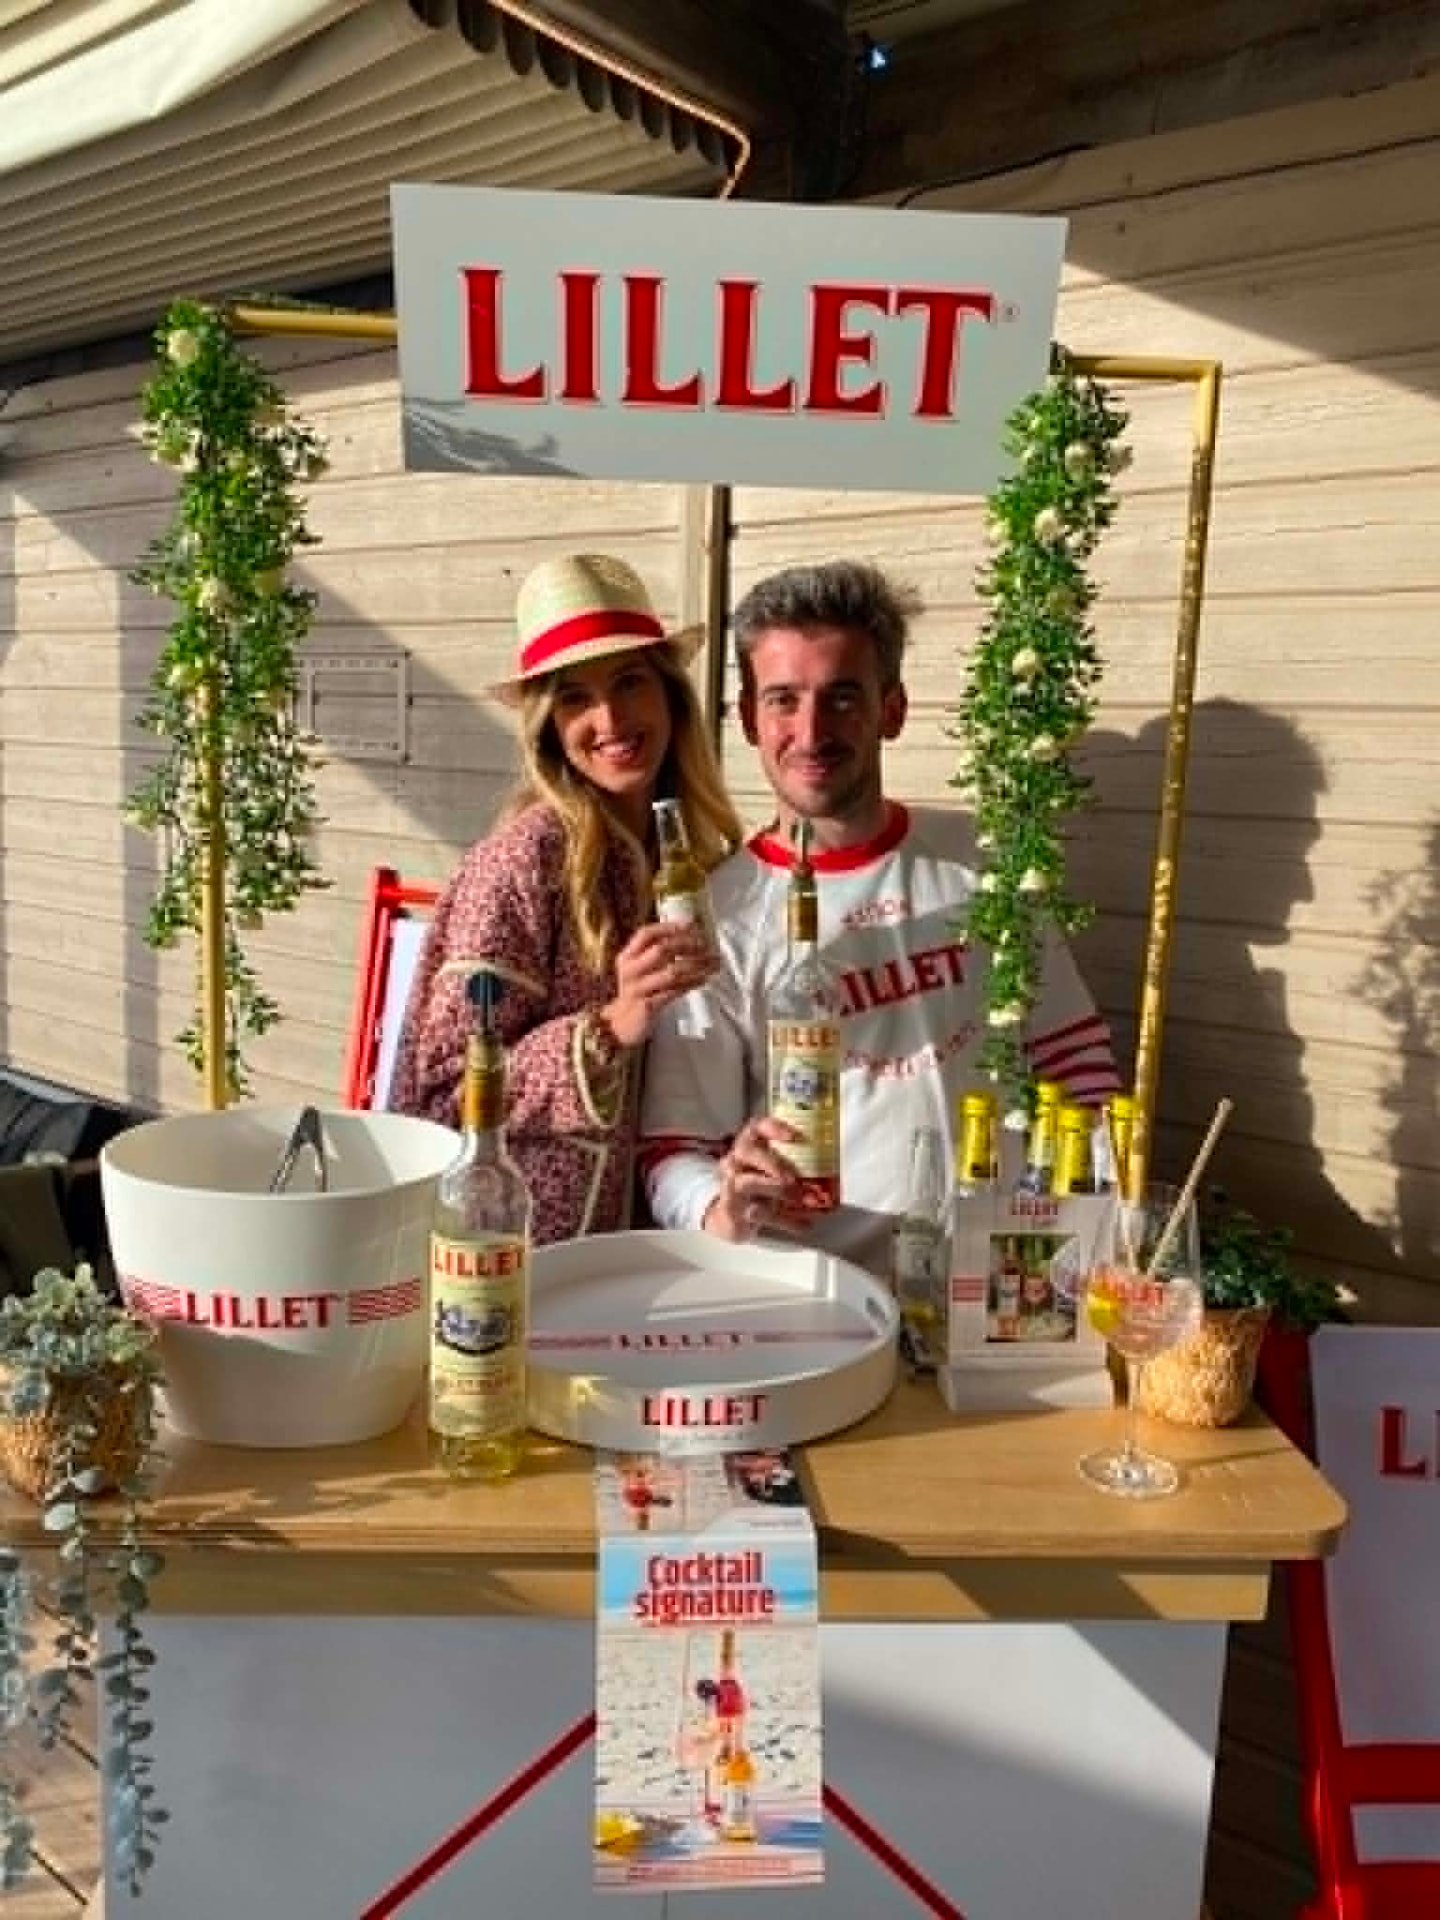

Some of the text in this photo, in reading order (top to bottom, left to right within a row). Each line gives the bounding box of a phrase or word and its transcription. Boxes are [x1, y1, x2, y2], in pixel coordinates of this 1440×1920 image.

[459, 264, 997, 421] LILLET
[180, 1291, 340, 1329] LILLET
[641, 1393, 767, 1427] LILLET
[646, 1551, 763, 1586] Cocktail
[635, 1587, 775, 1624] signature
